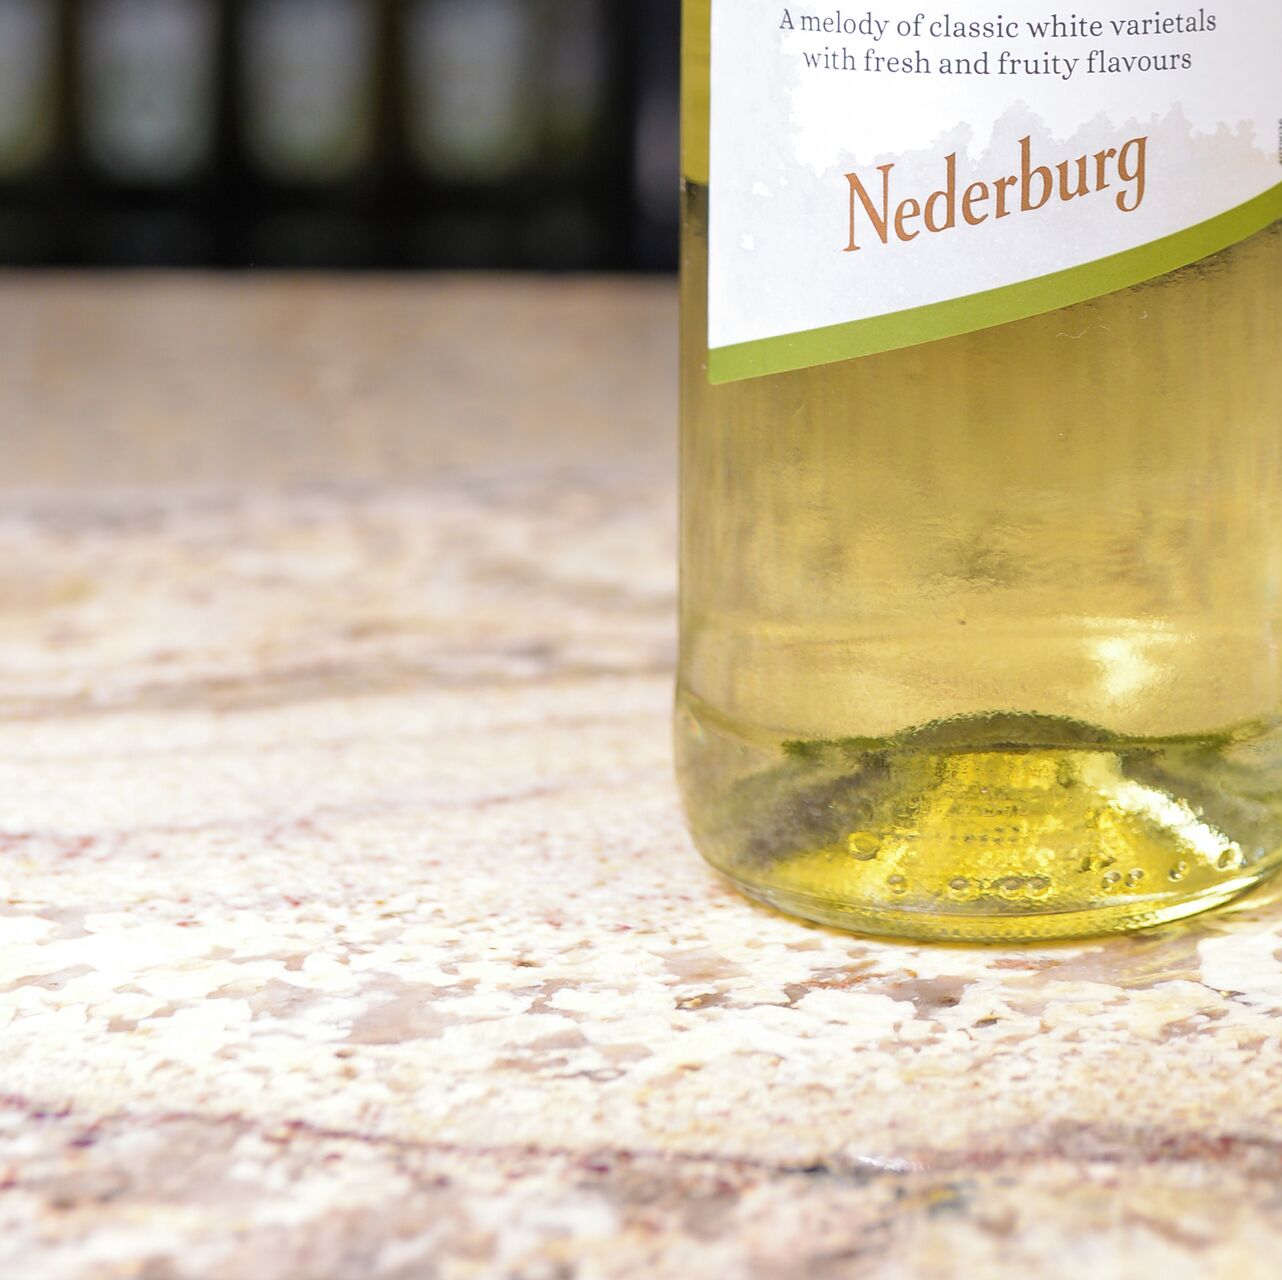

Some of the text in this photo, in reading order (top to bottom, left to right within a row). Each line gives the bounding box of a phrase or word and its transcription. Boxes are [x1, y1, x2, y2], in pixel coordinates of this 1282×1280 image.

[778, 8, 1217, 42] A melody of classic white varietals
[802, 46, 1192, 81] with fresh and fruity flavours
[841, 134, 1148, 253] Nederburg
